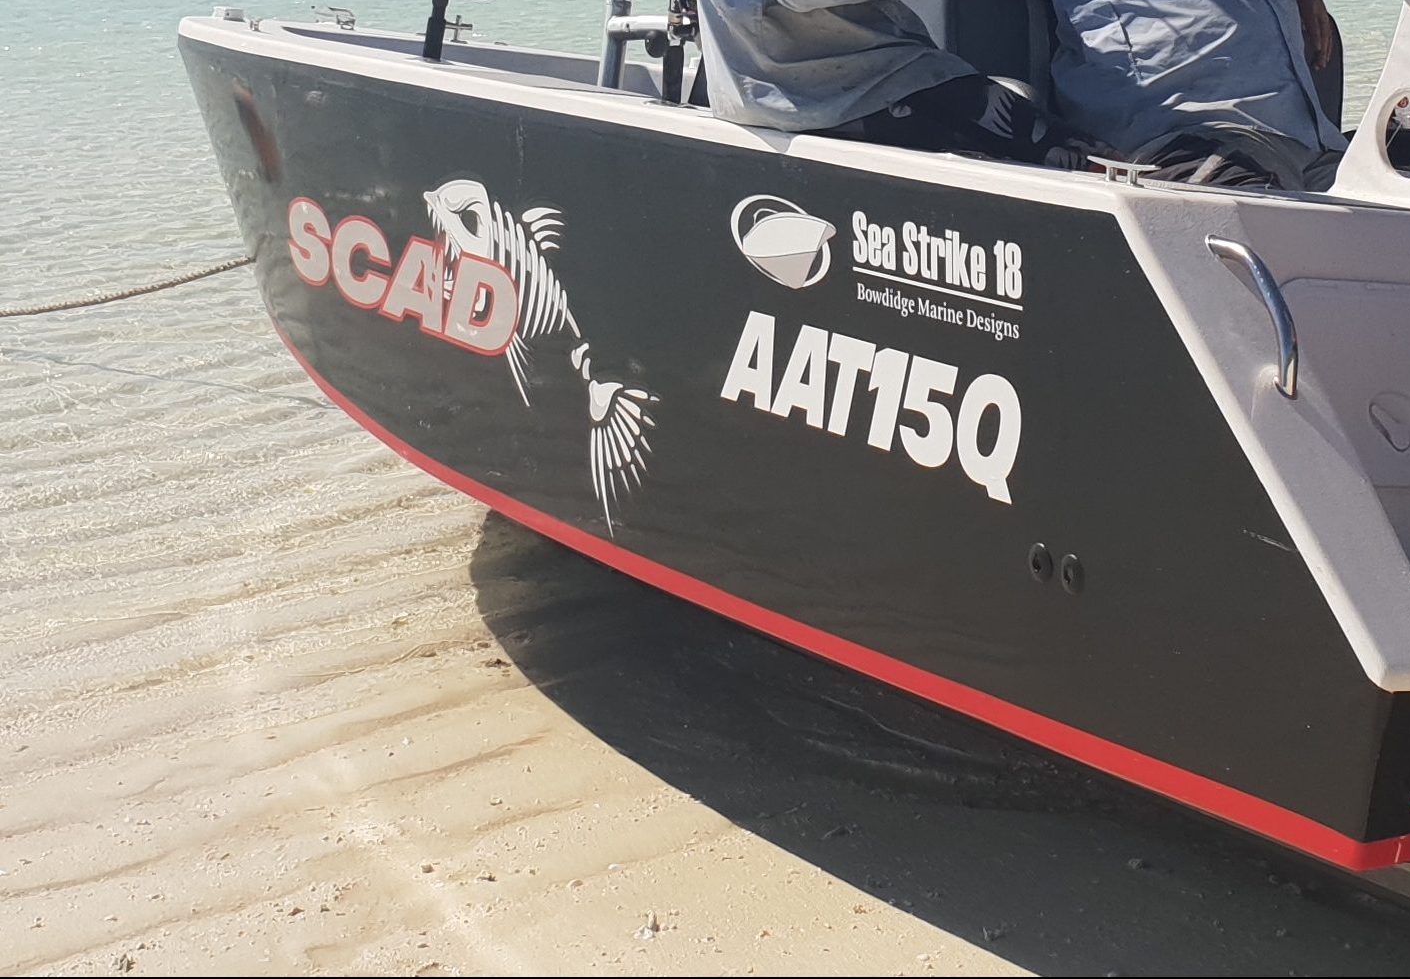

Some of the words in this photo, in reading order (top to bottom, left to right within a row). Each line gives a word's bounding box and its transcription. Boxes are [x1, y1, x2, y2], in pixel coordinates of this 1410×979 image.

[287, 196, 520, 357] SCAD
[852, 210, 897, 271] Sea
[902, 221, 987, 292] Strike
[993, 239, 1024, 300] 18
[856, 282, 915, 318] Bowdidge
[917, 297, 964, 326] Marine
[966, 309, 1020, 341] Designs
[720, 310, 1022, 505] AAT15Q
